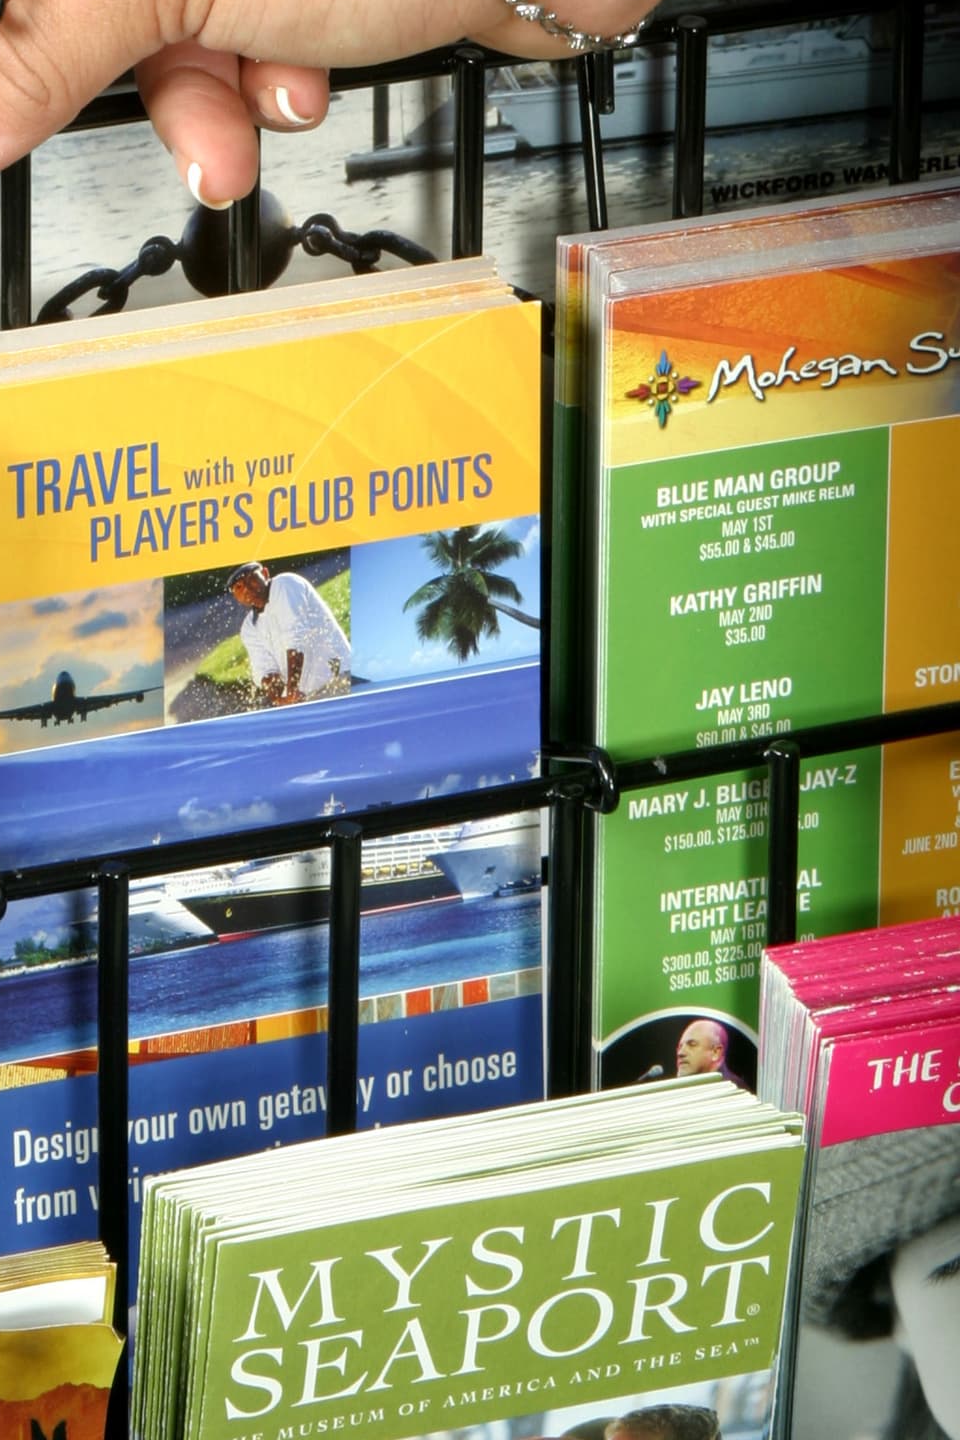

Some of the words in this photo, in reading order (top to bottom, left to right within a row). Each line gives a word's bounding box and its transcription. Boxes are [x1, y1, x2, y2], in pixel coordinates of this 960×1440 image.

[711, 171, 836, 203] WICKFORD
[706, 346, 897, 404] Mohegan
[7, 441, 171, 520] TRAVEL
[183, 456, 236, 491] with
[246, 451, 296, 488] your
[656, 480, 708, 508] BLUE
[714, 472, 765, 498] MAN
[770, 461, 841, 489] GROUP
[89, 492, 254, 563] PLAYER'S
[267, 476, 354, 533] CLUB
[368, 452, 493, 517] POINTS
[641, 512, 677, 529] WITH
[680, 504, 734, 523] SPECIAL
[737, 496, 779, 514] GUEST
[782, 490, 816, 507] MIKE
[819, 483, 855, 502] RELM
[722, 519, 748, 538] MAY
[752, 515, 774, 534] 1ST
[699, 540, 740, 562] $55.00
[754, 531, 796, 553] $45.00
[670, 587, 738, 616] KATHY
[743, 574, 822, 604] GRIFFIN
[719, 609, 745, 628] MAY
[749, 604, 773, 623] 2ND
[725, 624, 766, 647] $35.00
[695, 686, 734, 711] JAY
[740, 677, 792, 702] LENO
[717, 707, 744, 727] MAY
[747, 703, 771, 721] 3RD
[696, 728, 737, 748] $60.00
[628, 792, 688, 820] MARY
[693, 788, 710, 808] J.
[799, 766, 857, 792] JAY-Z
[716, 806, 742, 824] MAY
[745, 801, 768, 819] 8TH
[717, 822, 764, 843] $125.00
[902, 835, 932, 855] JUNE
[934, 832, 958, 851] 2ND
[670, 906, 729, 934] FIGHT
[710, 926, 736, 946] MAY
[715, 962, 755, 984] $50.00
[867, 1049, 943, 1091] THE
[189, 1098, 247, 1134] own
[386, 1070, 413, 1099] or
[423, 1049, 517, 1093] choose
[14, 1187, 77, 1225] from
[233, 1181, 775, 1343] MYSTIC
[276, 1408, 386, 1440] MUSEUM
[398, 1398, 433, 1415] OF
[442, 1377, 558, 1408] AMERICA
[569, 1364, 622, 1384] AND
[632, 1352, 683, 1372] THE
